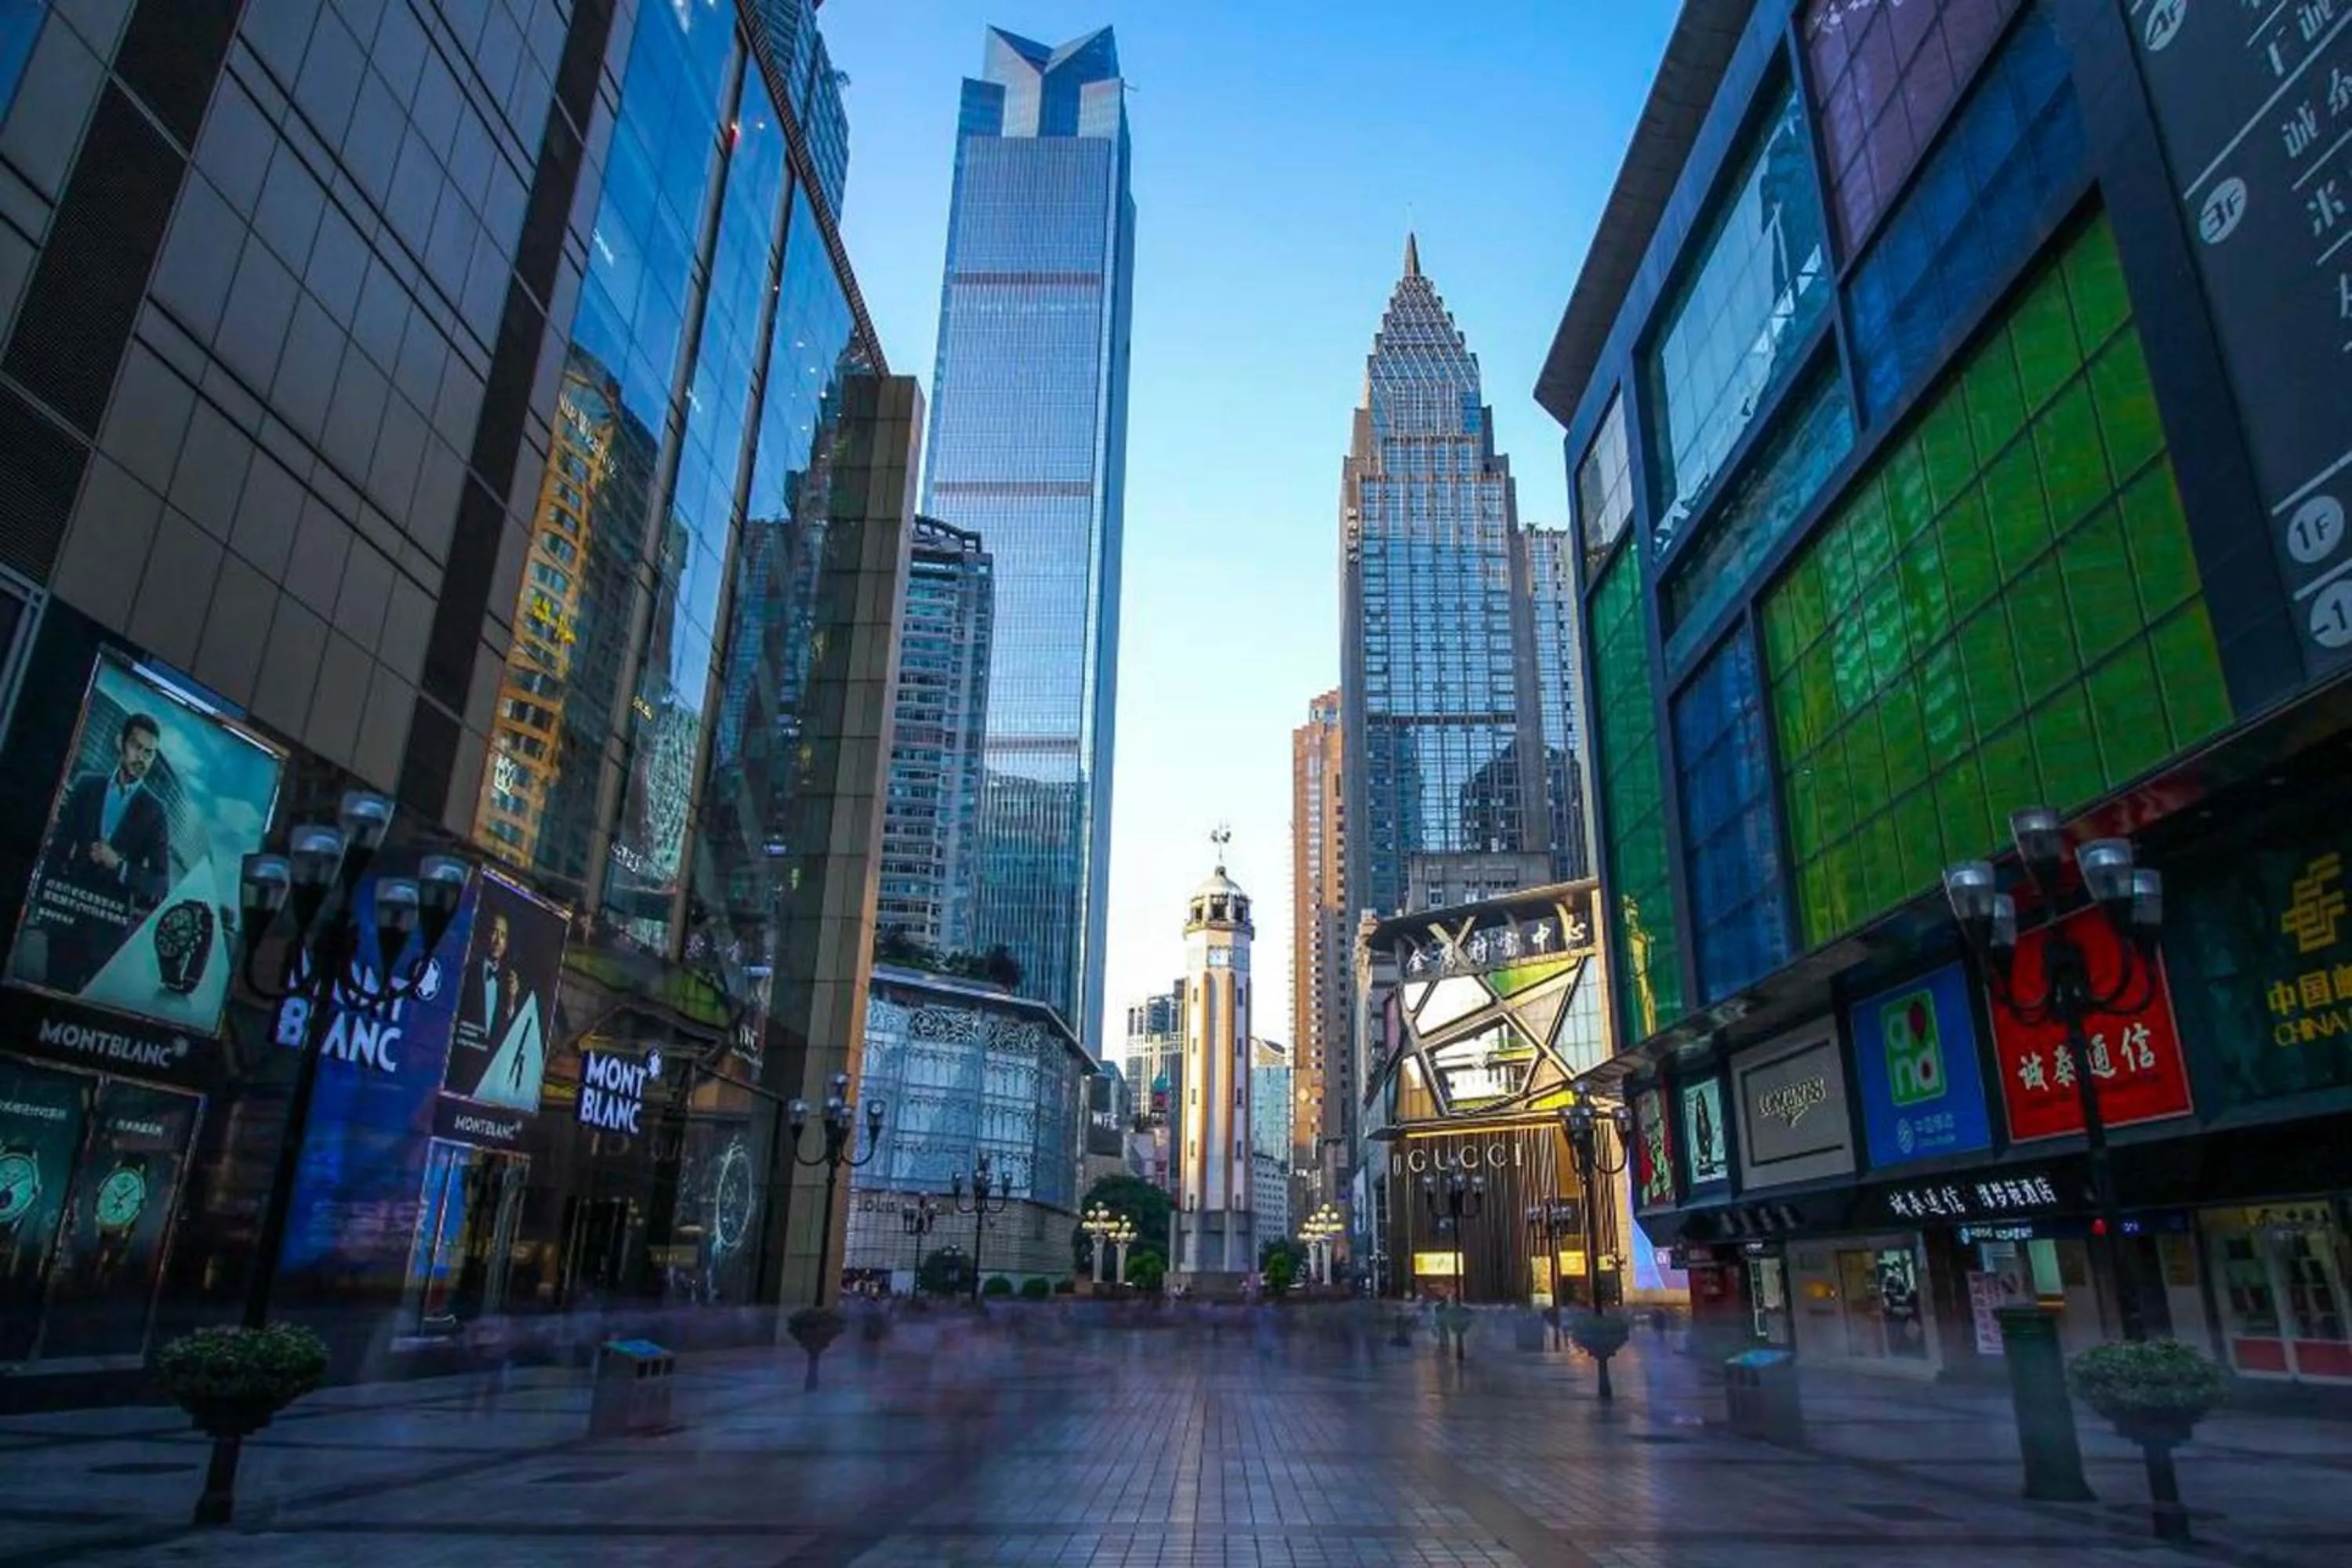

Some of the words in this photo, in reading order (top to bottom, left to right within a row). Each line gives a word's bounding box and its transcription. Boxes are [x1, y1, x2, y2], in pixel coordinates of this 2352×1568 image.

[2199, 187, 2241, 238] 3F
[2295, 512, 2331, 551] 1F
[39, 1019, 172, 1068] MONTBLANC
[276, 996, 402, 1073] BANC
[586, 1049, 648, 1098] MONT
[454, 1114, 514, 1141] MONTBLANC
[580, 1087, 642, 1134] BLANC
[1408, 1142, 1524, 1173] GUCCI
